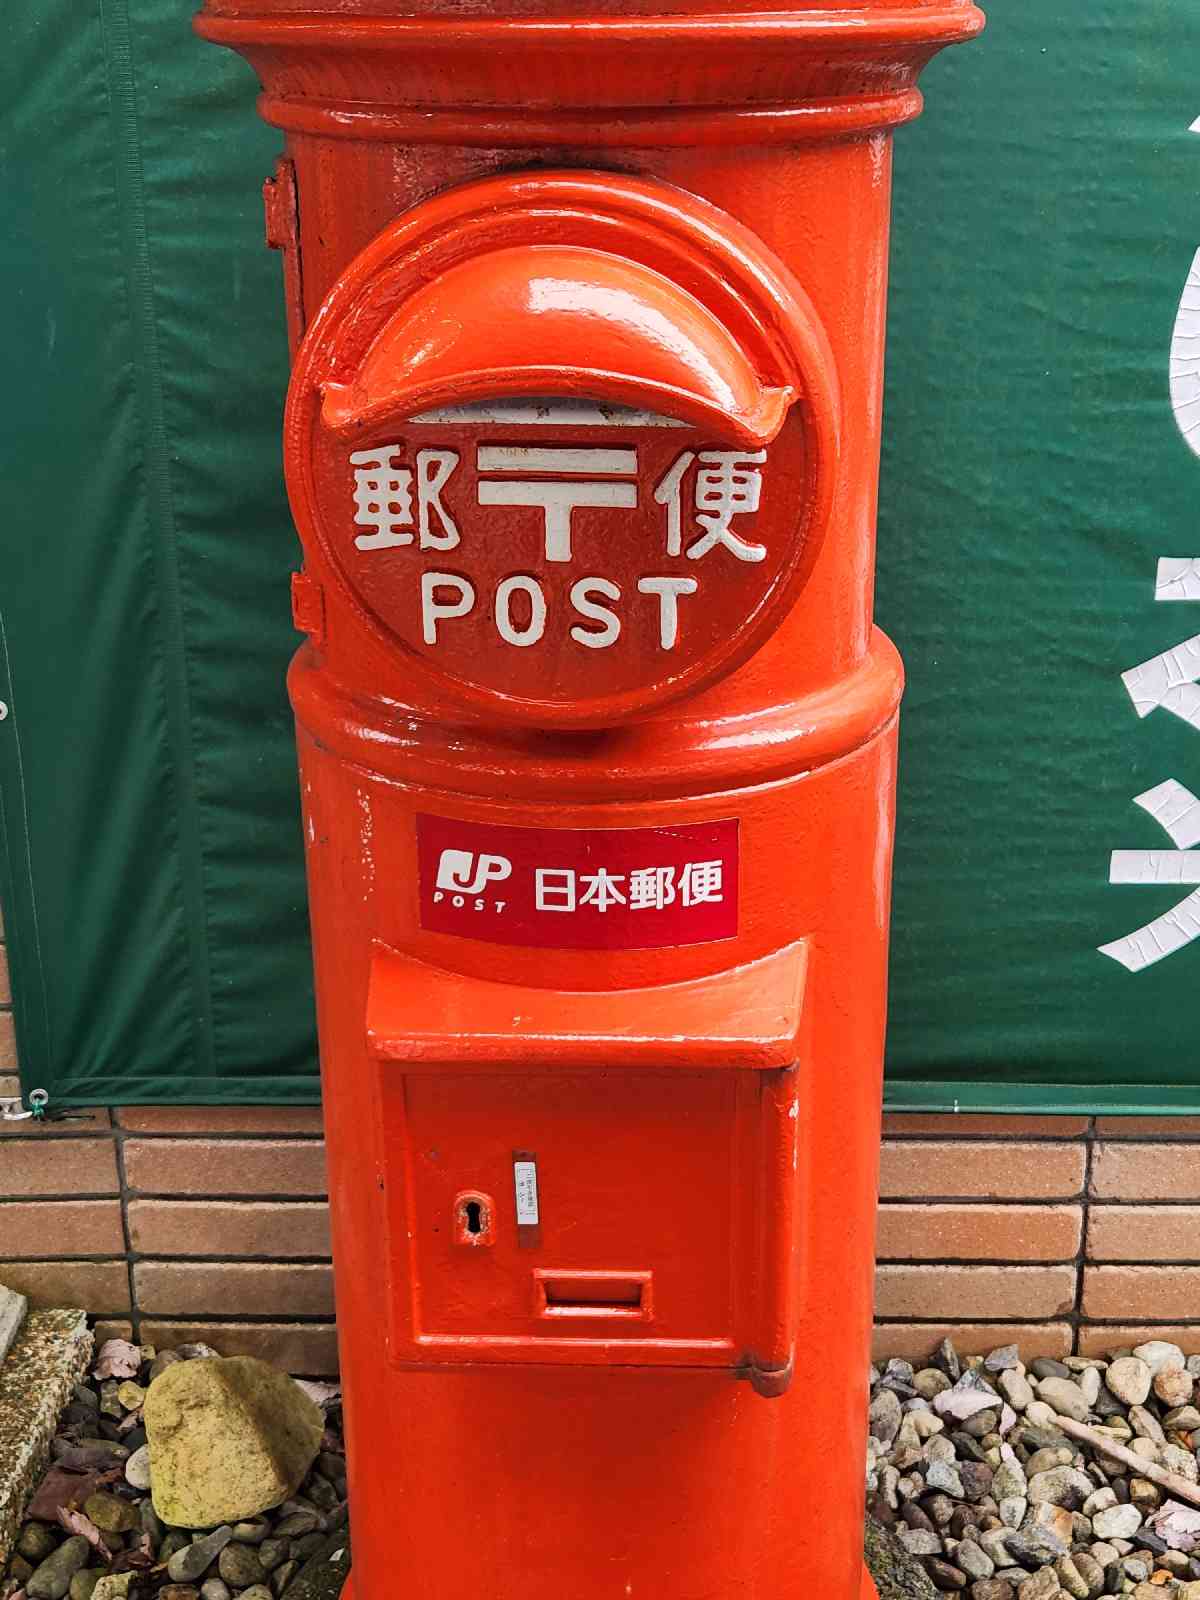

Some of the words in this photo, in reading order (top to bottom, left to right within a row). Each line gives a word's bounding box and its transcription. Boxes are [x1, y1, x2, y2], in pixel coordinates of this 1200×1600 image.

[421, 573, 697, 650] POST
[436, 849, 512, 894] JP
[535, 860, 723, 912] 日本郵便
[433, 891, 506, 913] POST
